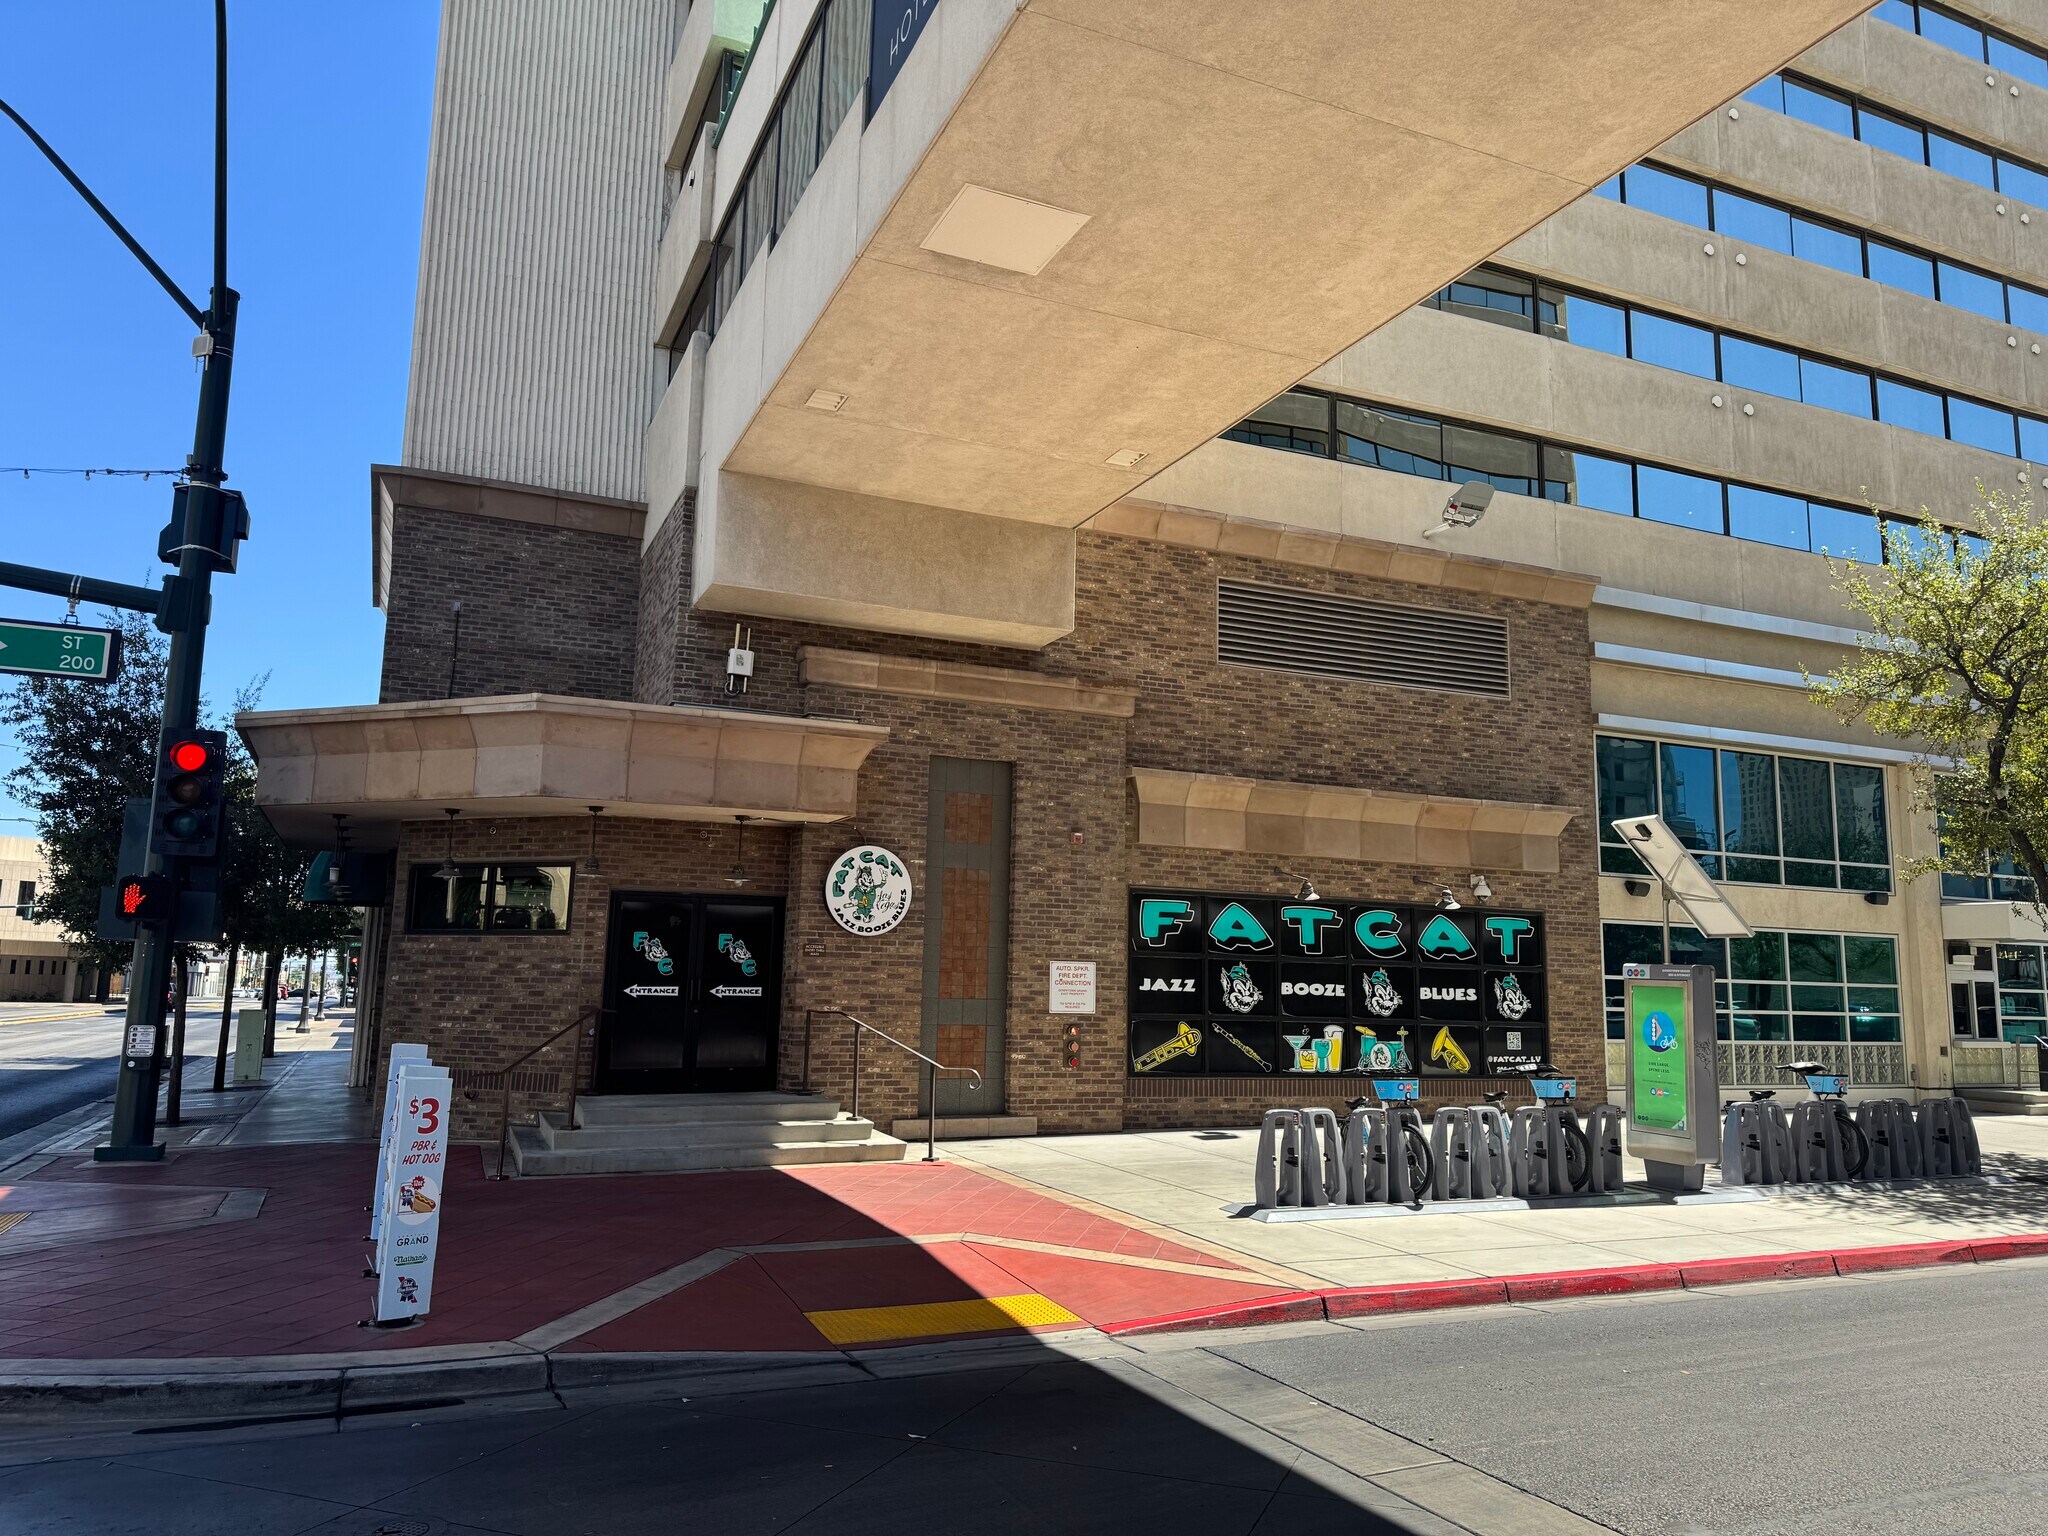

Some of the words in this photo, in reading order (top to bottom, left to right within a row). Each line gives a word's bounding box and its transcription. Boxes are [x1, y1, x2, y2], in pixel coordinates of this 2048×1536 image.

[62, 635, 84, 650] ST
[59, 655, 95, 671] 200
[832, 856, 855, 897] FAT
[859, 851, 903, 878] CAT
[834, 907, 856, 930] JAZZ
[857, 919, 892, 933] BOOZE
[892, 888, 907, 922] BLUES
[1139, 899, 1344, 955] FAT
[1355, 910, 1535, 964] CAT
[633, 931, 649, 951] F
[718, 933, 733, 953] F
[657, 958, 673, 975] C
[742, 959, 757, 977] C
[1139, 978, 1196, 992] JAZZ
[1281, 982, 1346, 997] BOOZE
[1419, 987, 1478, 1001] BLUES
[1487, 1055, 1541, 1063] @FATCAT_LV
[409, 1095, 440, 1135] $3
[411, 1140, 430, 1151] PBR
[402, 1154, 422, 1165] HOT
[422, 1153, 441, 1164] DOG
[396, 1235, 429, 1247] GRAND
